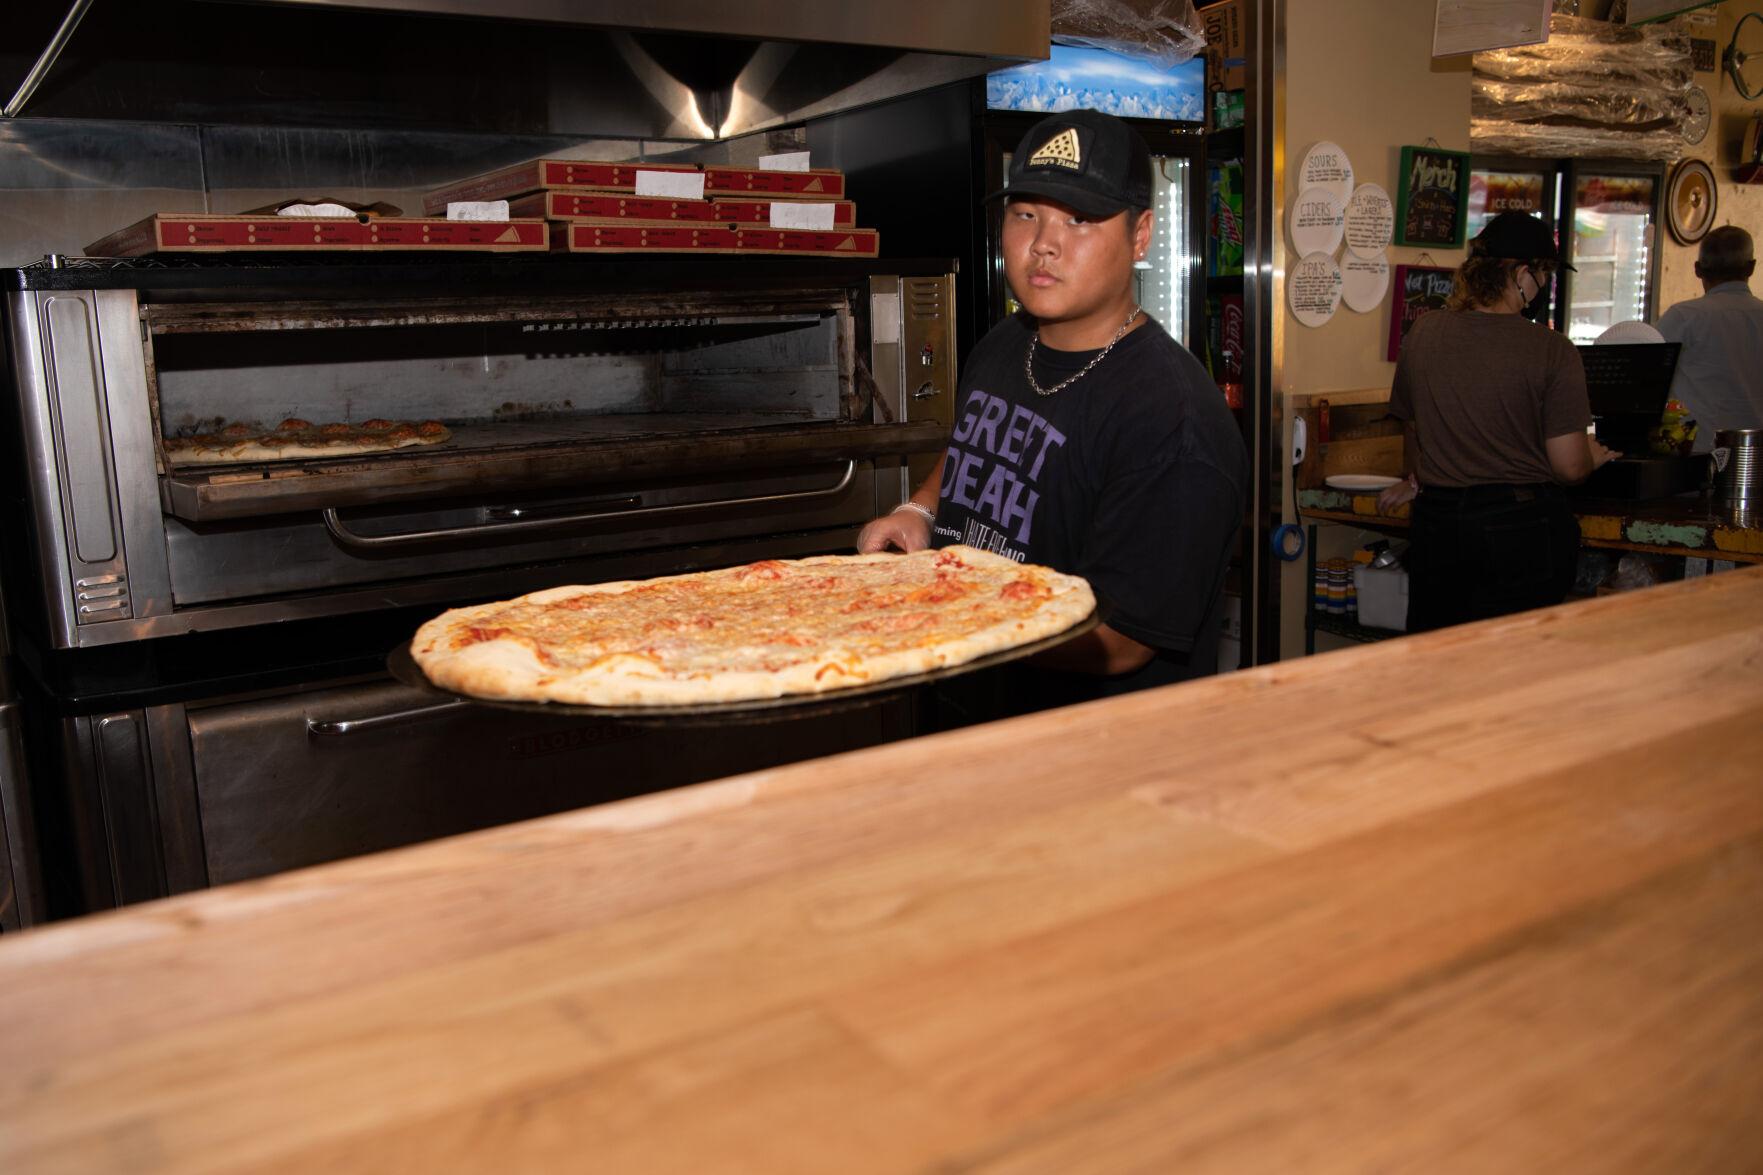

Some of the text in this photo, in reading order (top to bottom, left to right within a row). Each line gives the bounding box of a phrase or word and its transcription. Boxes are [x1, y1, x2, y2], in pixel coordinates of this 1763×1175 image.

[1308, 154, 1338, 169] SOURS
[1409, 155, 1458, 193] Merch
[1300, 201, 1332, 217] CIDERS
[1491, 198, 1533, 211] ICE COLD
[940, 446, 1040, 545] DEAH
